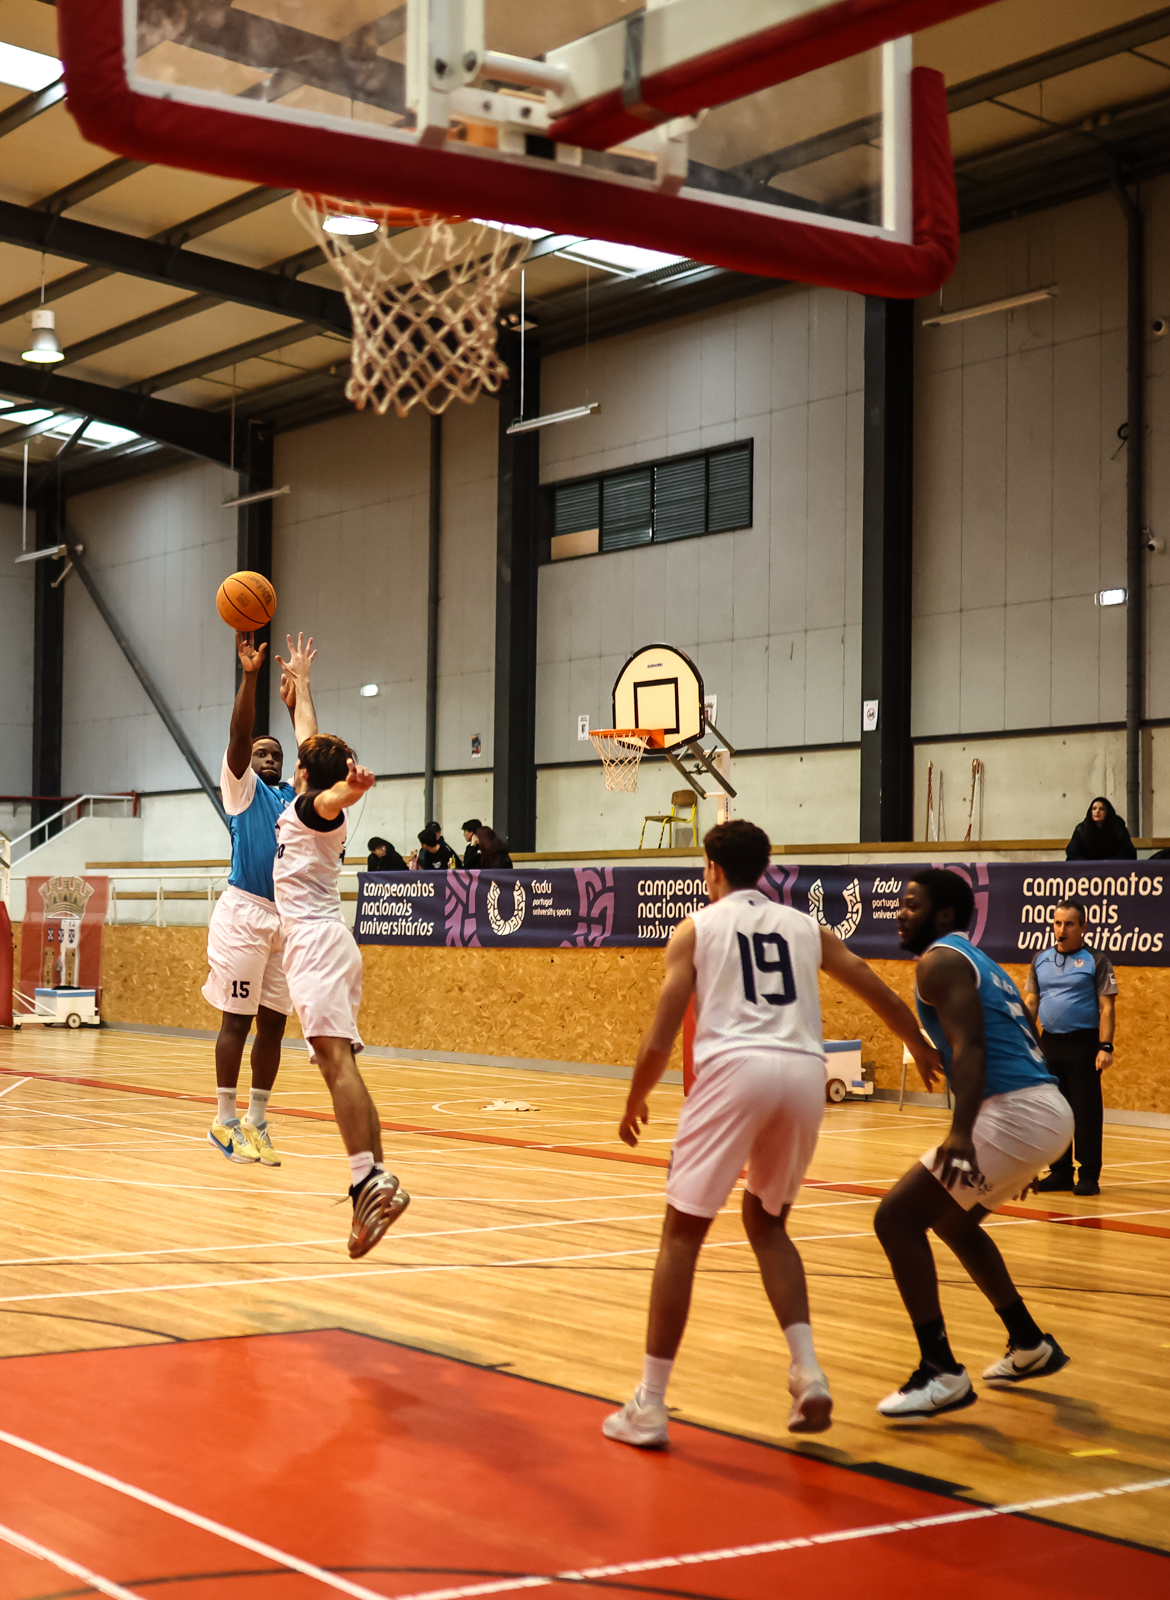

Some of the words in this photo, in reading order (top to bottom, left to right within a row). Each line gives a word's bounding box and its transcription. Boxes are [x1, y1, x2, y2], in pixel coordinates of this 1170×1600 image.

[363, 880, 435, 900] campeonatos
[531, 879, 552, 894] fadu
[872, 877, 903, 893] fadu
[1022, 872, 1164, 900] campeonatos
[361, 899, 412, 916] nacionais
[532, 897, 553, 907] portugal
[872, 898, 900, 908] portugal
[532, 907, 556, 917] university
[556, 907, 572, 917] sports
[359, 917, 434, 936] universitários
[736, 931, 798, 1007] 19
[231, 980, 251, 999] 15
